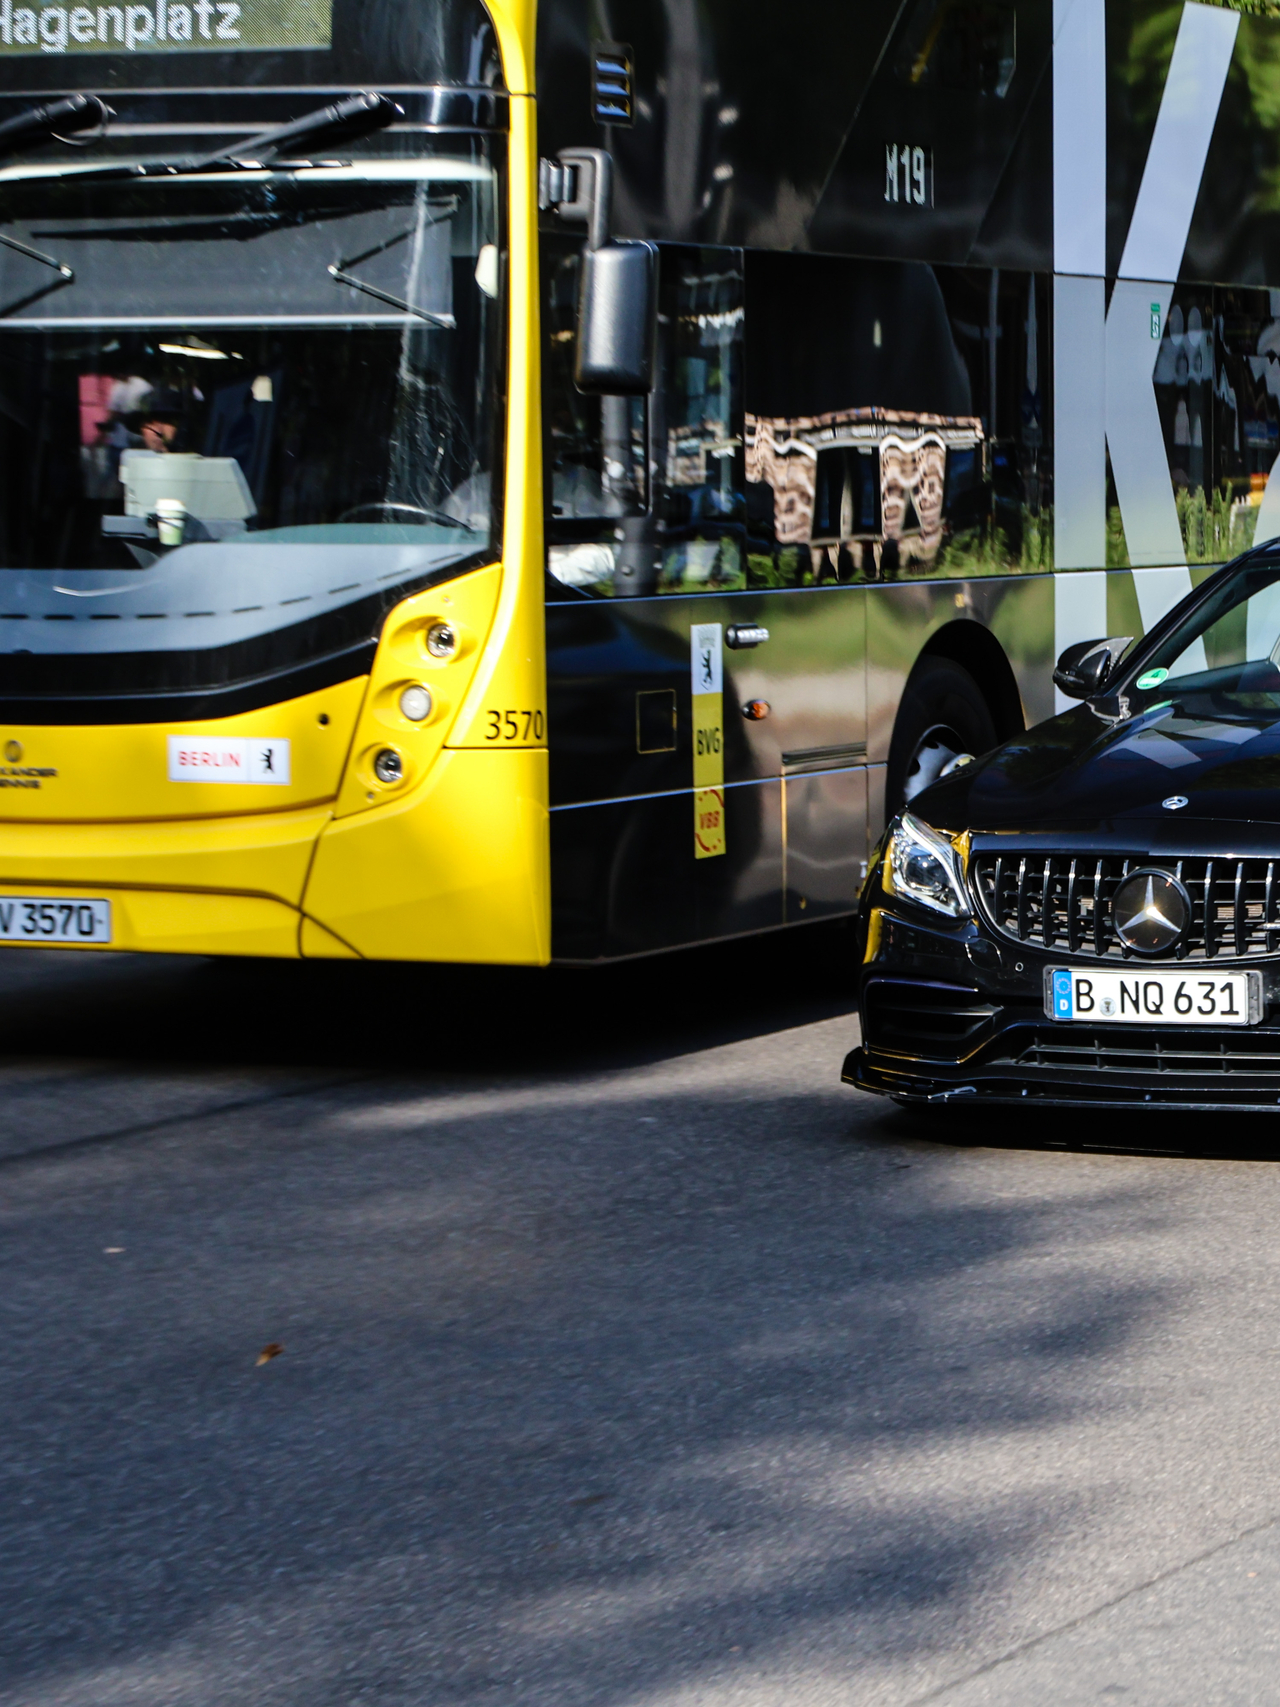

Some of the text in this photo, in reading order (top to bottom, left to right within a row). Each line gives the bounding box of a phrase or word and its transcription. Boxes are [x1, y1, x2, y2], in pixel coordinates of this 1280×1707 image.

[884, 143, 925, 205] M19
[485, 710, 544, 740] 3570
[696, 727, 720, 755] BVG
[178, 750, 241, 767] BERLIN
[699, 811, 720, 830] VBB
[21, 903, 95, 936] 3570
[1059, 999, 1067, 1010] D
[1075, 979, 1240, 1016] B NQ 631
